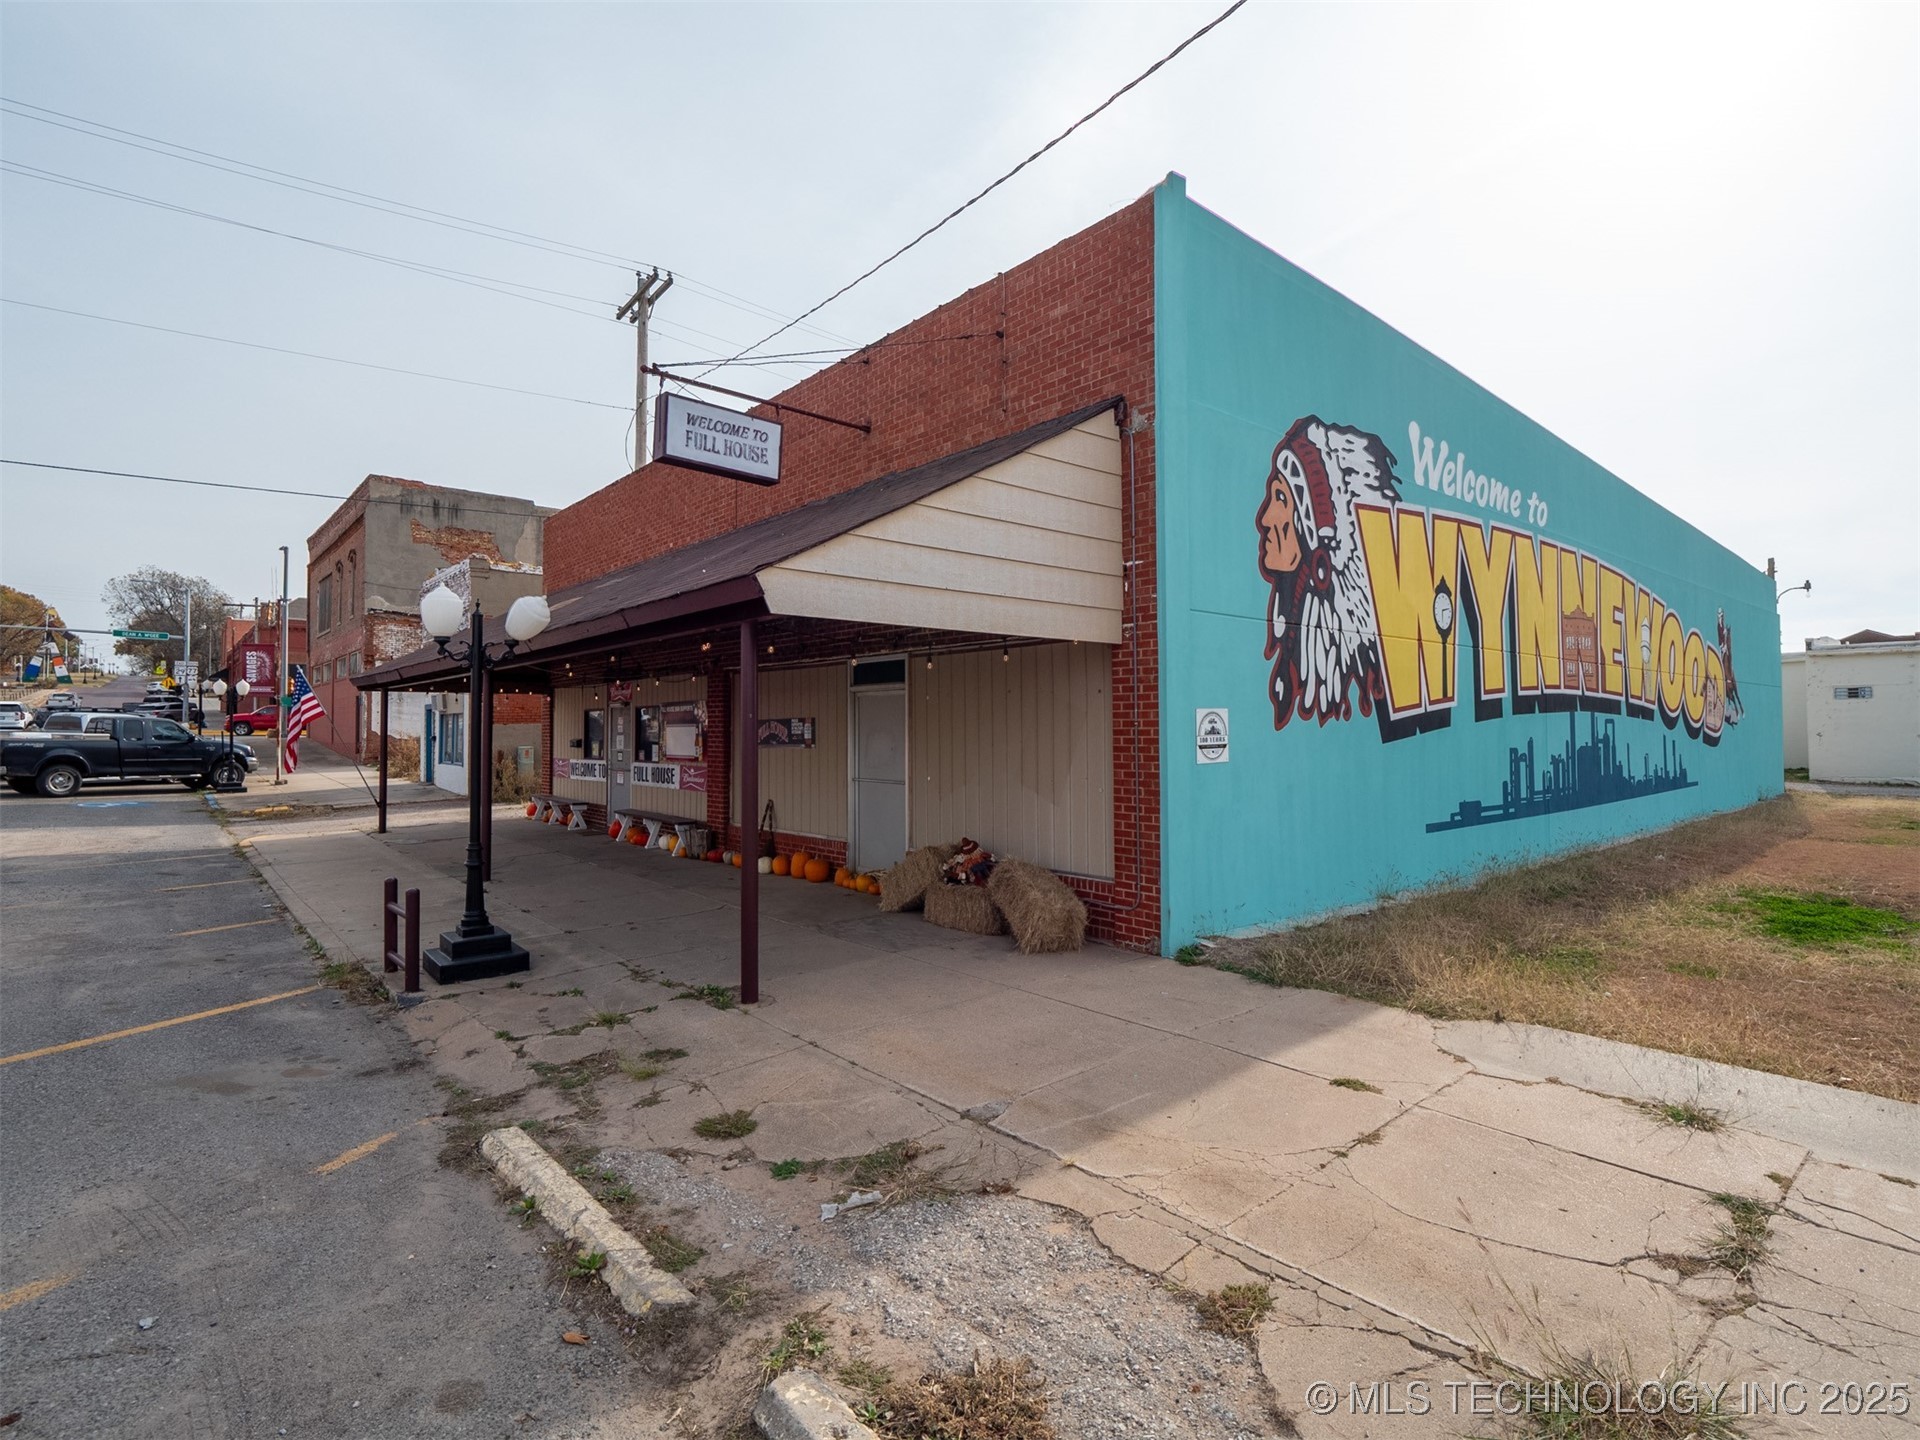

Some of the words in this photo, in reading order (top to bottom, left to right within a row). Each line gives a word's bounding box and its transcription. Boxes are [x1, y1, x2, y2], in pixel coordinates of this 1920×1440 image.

[686, 412, 750, 440] WELCOME
[753, 429, 769, 443] TO
[685, 429, 721, 455] FULL
[723, 438, 769, 465] HOUSE
[1408, 420, 1521, 517] Welcome
[1527, 491, 1548, 527] to
[1353, 500, 1728, 740] WYNNEWOOD
[245, 651, 257, 683] SAVAGES
[570, 762, 597, 778] WELCOME
[598, 763, 606, 779] TO
[633, 766, 649, 782] FULL
[651, 767, 676, 785] HOUSE
